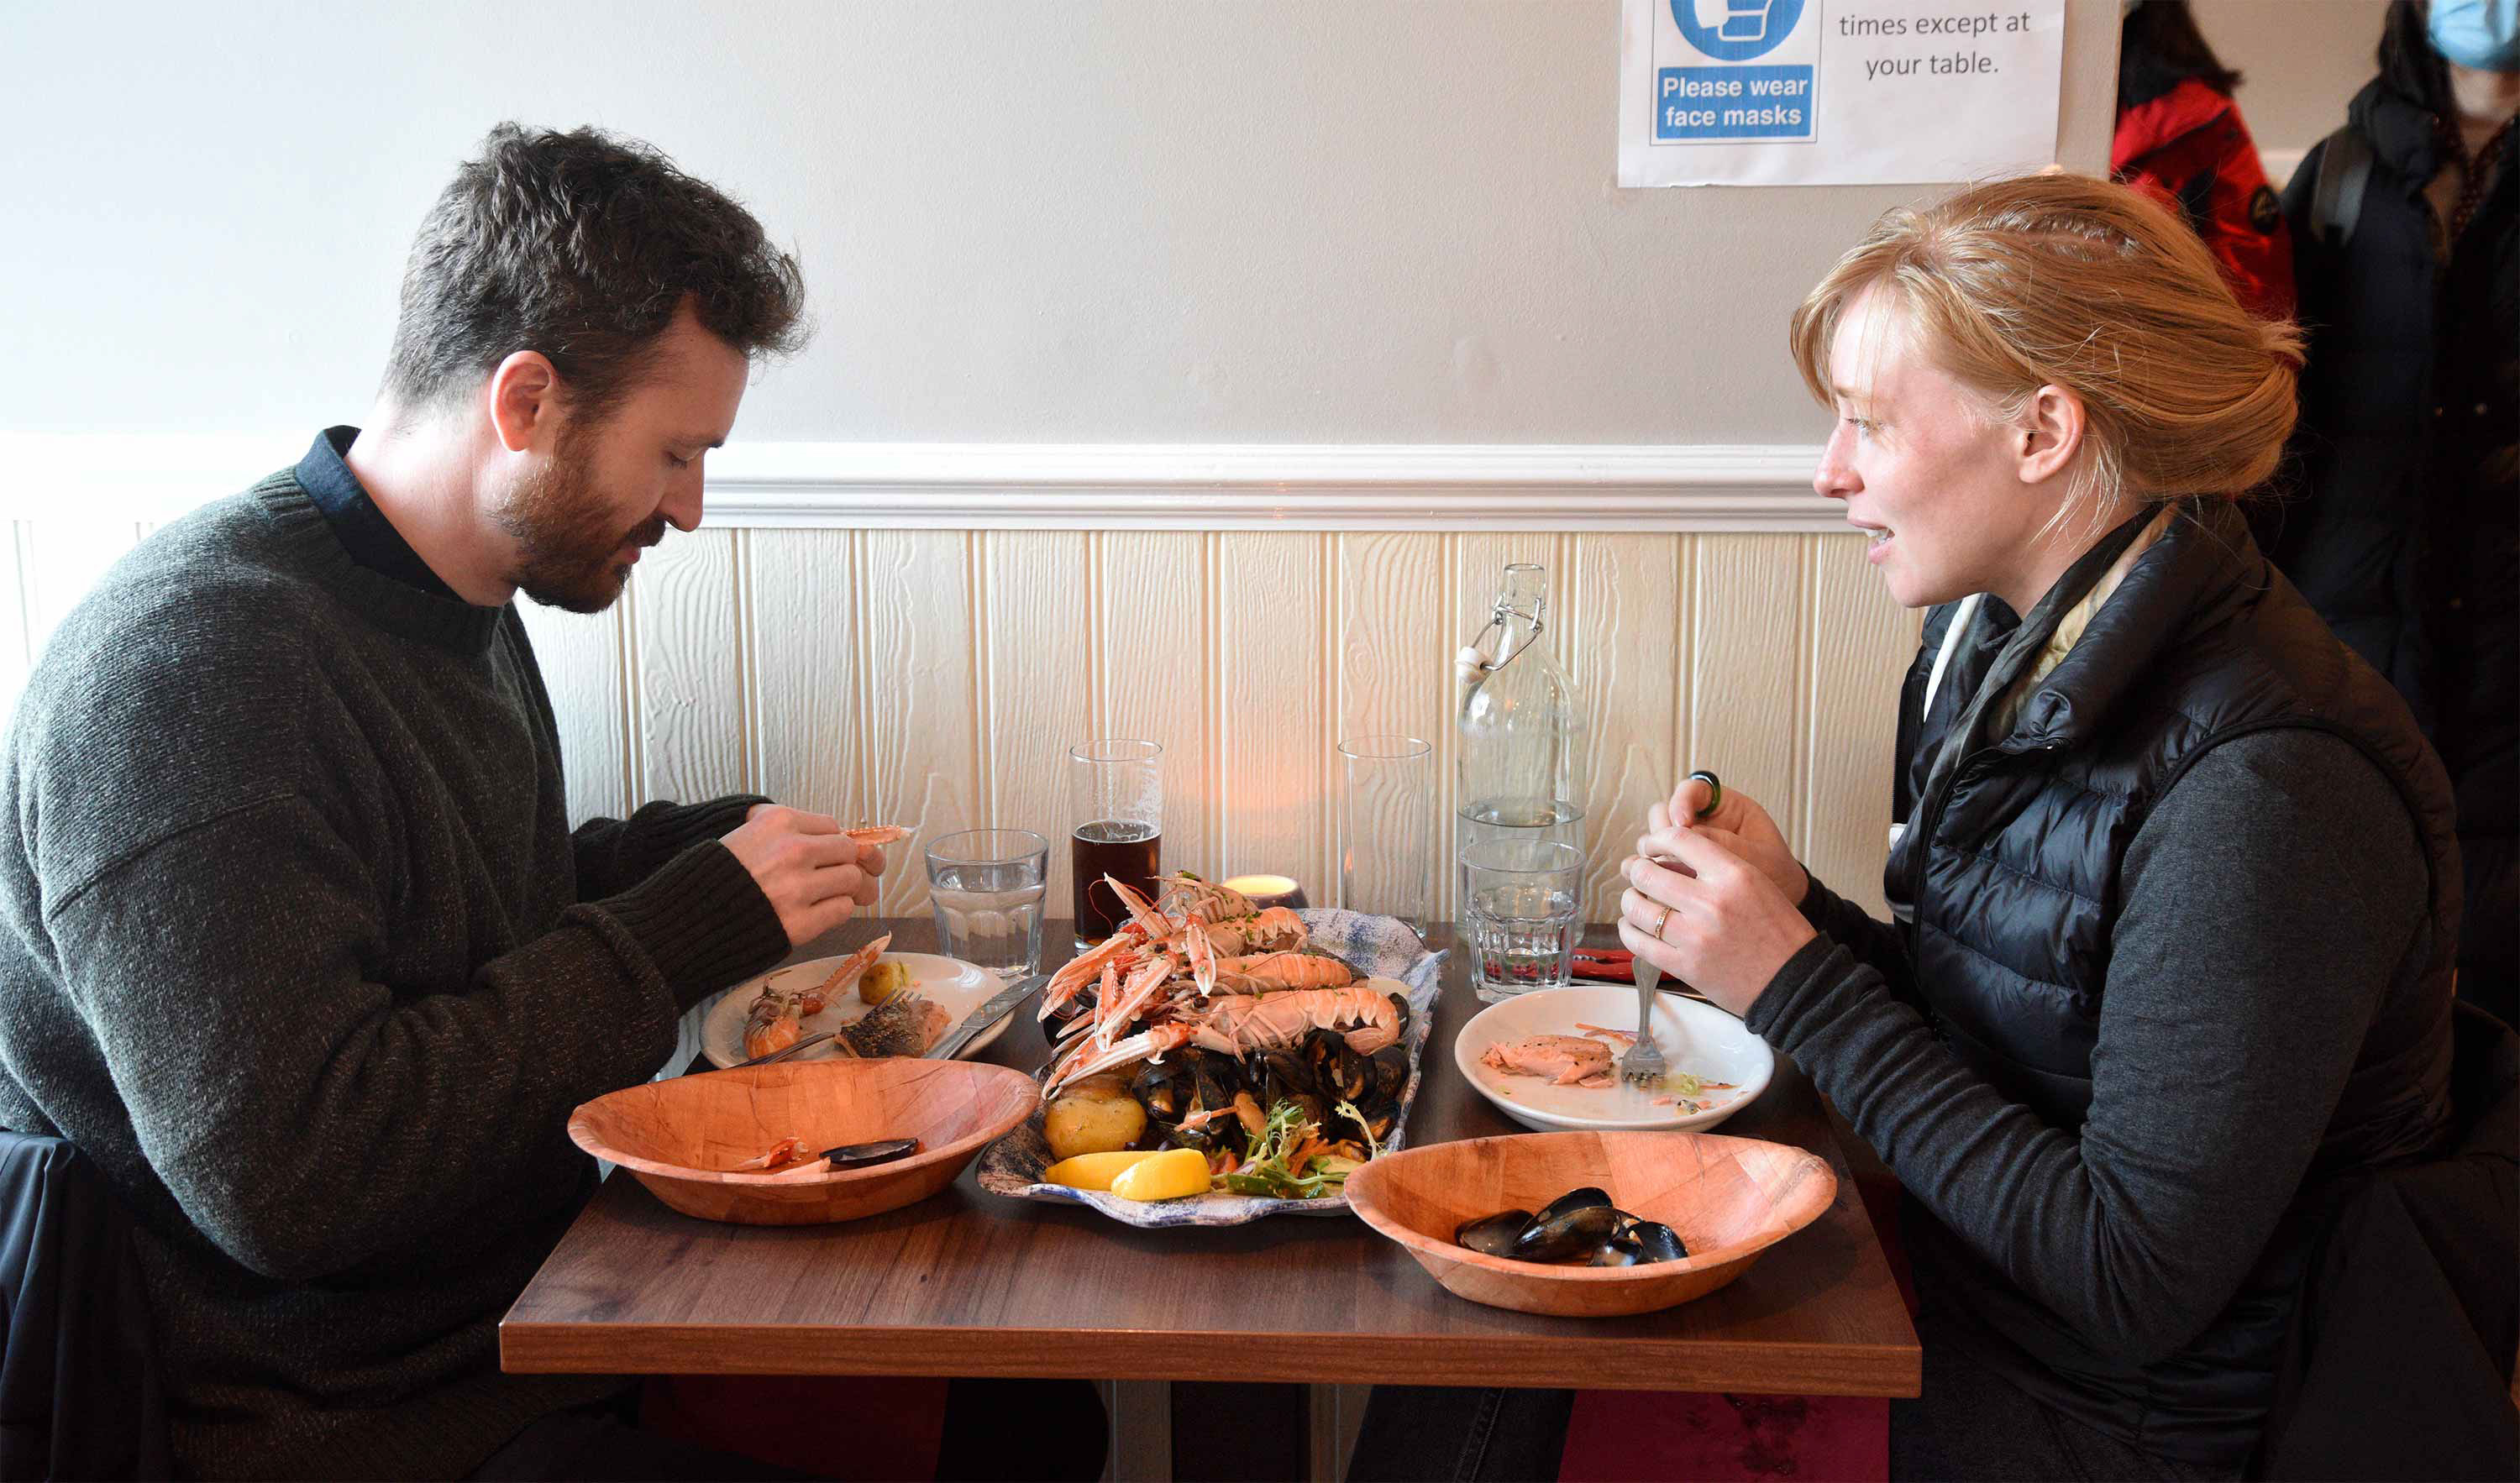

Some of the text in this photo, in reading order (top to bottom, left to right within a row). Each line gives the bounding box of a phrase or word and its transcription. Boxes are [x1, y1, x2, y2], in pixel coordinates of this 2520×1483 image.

[1839, 12, 2031, 38] times except at
[1866, 50, 1999, 81] your table.
[1662, 76, 1809, 98] Please wear
[1665, 104, 1803, 127] face masks
